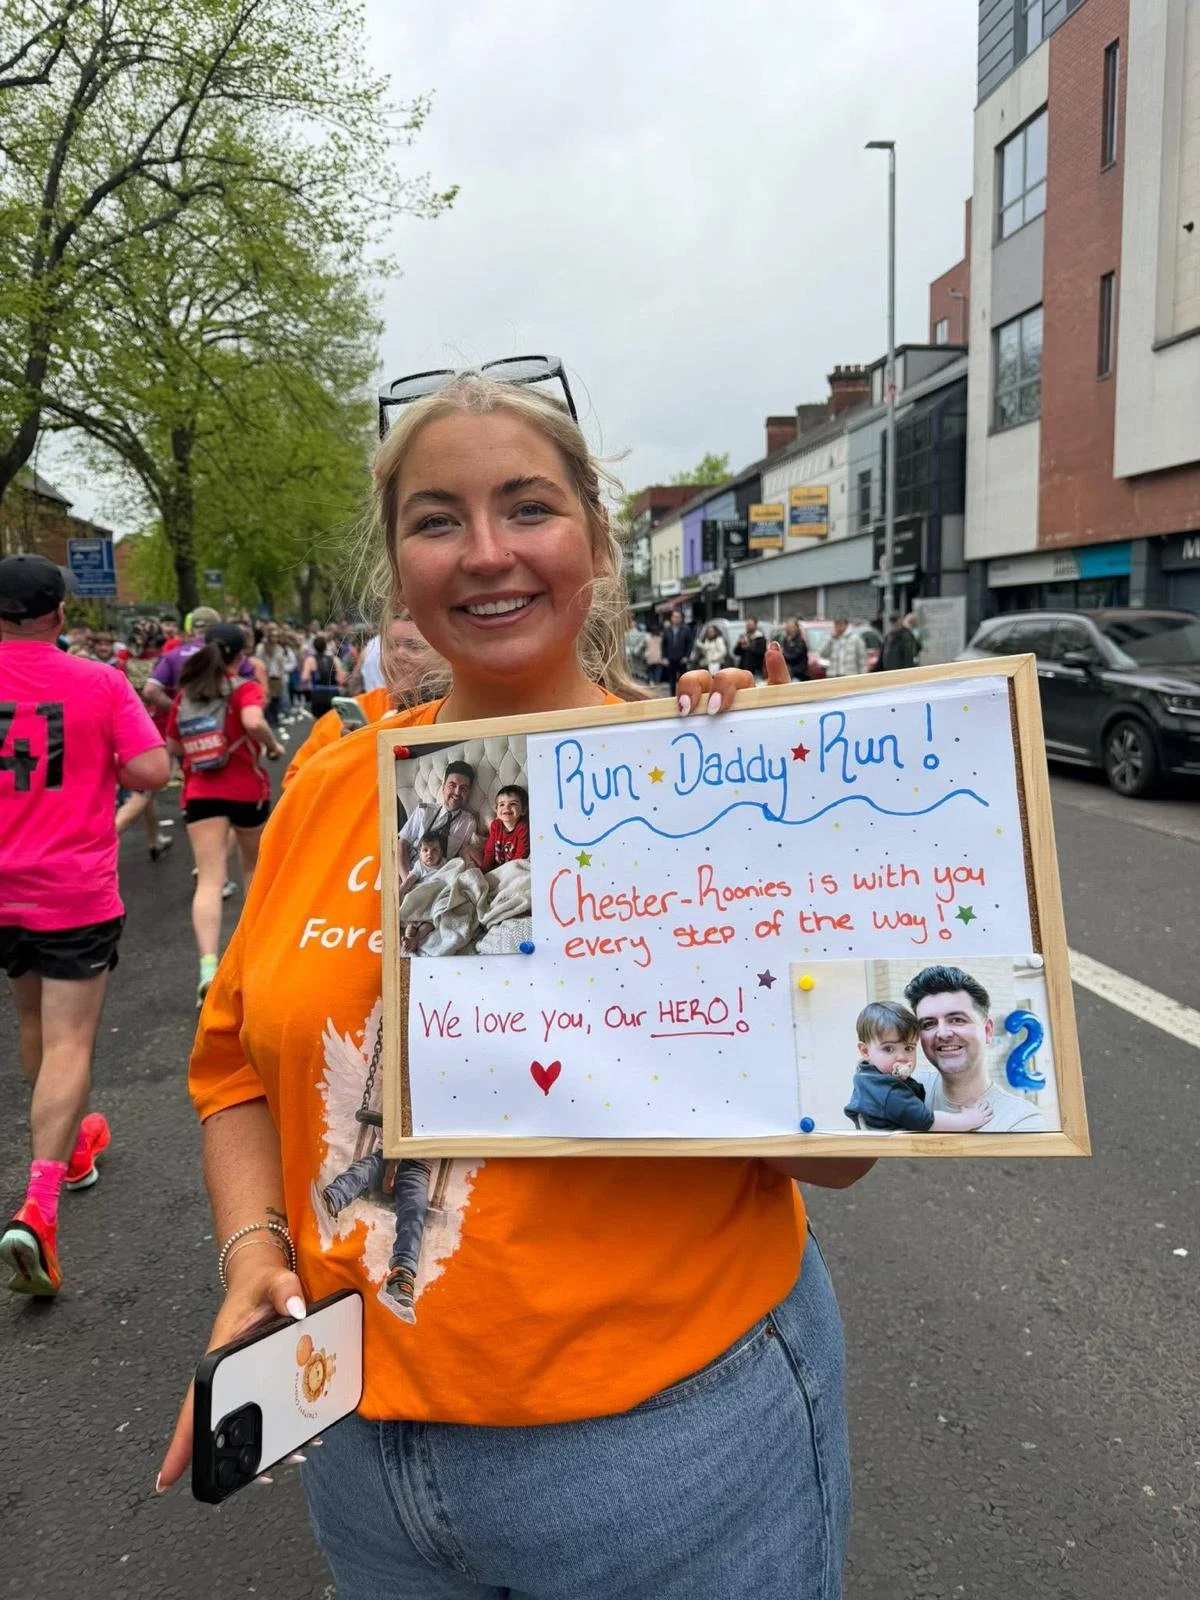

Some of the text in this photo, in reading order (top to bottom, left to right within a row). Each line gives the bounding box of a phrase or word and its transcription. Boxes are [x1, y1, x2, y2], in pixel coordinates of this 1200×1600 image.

[555, 739, 640, 816] Run
[671, 732, 788, 820] Daddy
[808, 871, 838, 895] is
[853, 864, 920, 890] with
[934, 864, 986, 904] you
[564, 935, 650, 968] every
[672, 923, 736, 948] step
[754, 909, 785, 939] of
[799, 909, 855, 933] the
[418, 1000, 463, 1039] We
[474, 1005, 527, 1034] love
[541, 1009, 591, 1043] you,
[658, 986, 750, 1034] HERO!
